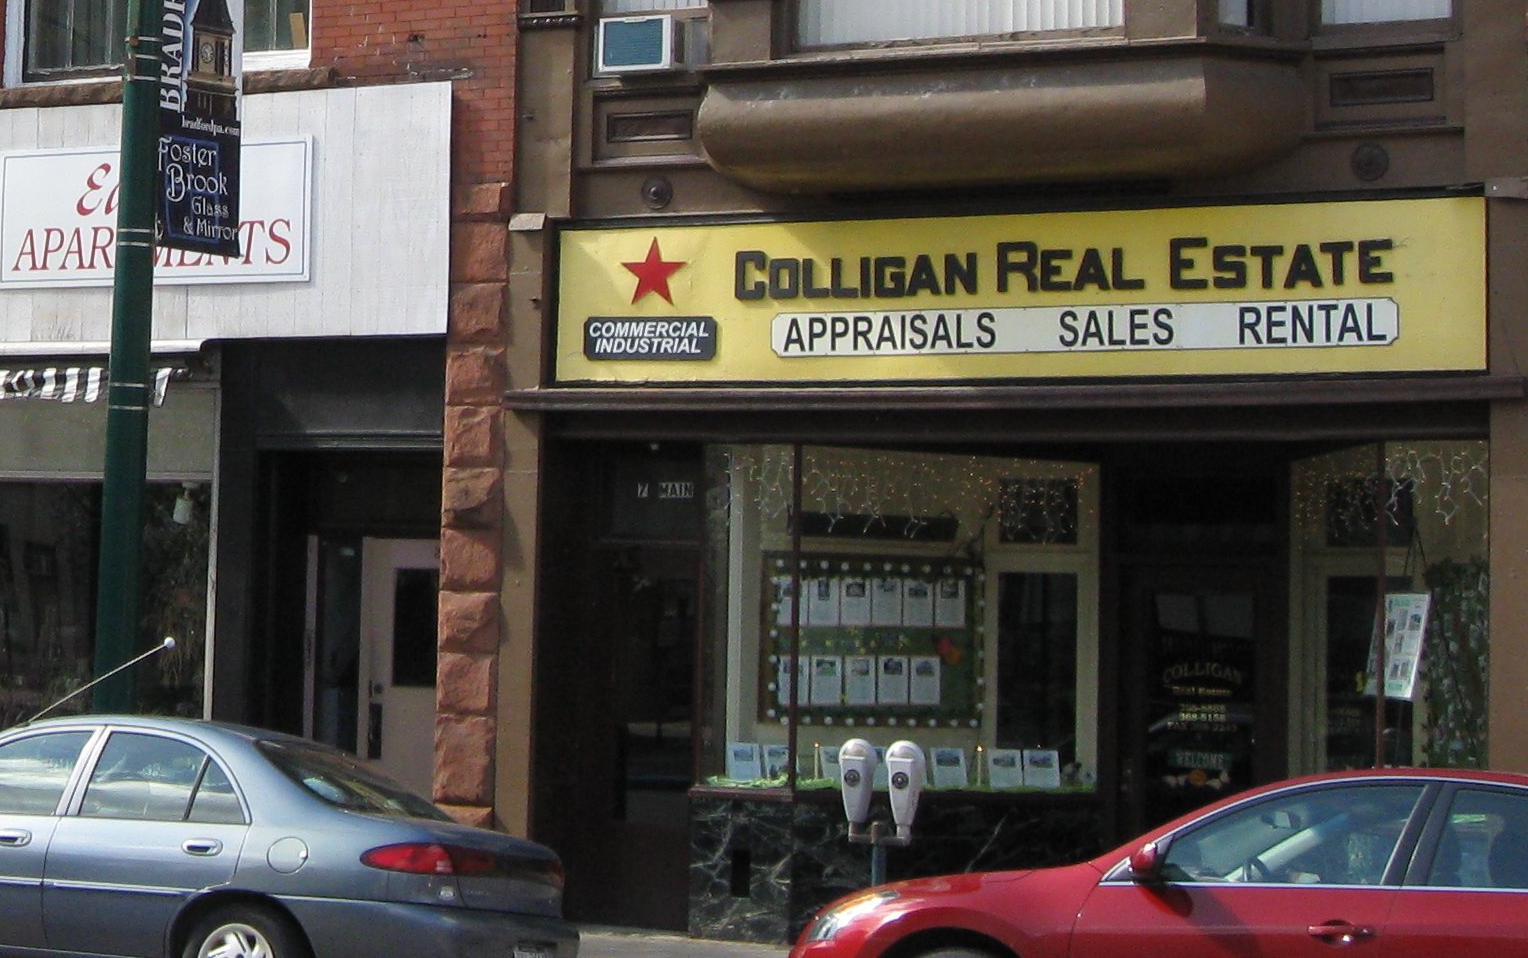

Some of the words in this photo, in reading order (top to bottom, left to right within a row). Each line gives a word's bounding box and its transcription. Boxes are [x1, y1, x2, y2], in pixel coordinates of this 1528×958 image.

[158, 137, 217, 171] Foster
[166, 163, 228, 202] Brook
[192, 196, 229, 218] Glass
[183, 216, 194, 235] &
[196, 218, 238, 240] Mirror
[735, 250, 978, 300] COLLIGAN
[997, 241, 1145, 293] REAL
[1170, 237, 1394, 289] ESTATE
[589, 321, 710, 338] COMMERCIAL
[783, 312, 997, 352] APPRAISALS
[1059, 307, 1174, 347] SALES
[1238, 302, 1388, 345] RENTAL
[595, 338, 702, 354] INDUSTRIAL
[658, 482, 694, 498] MAIN
